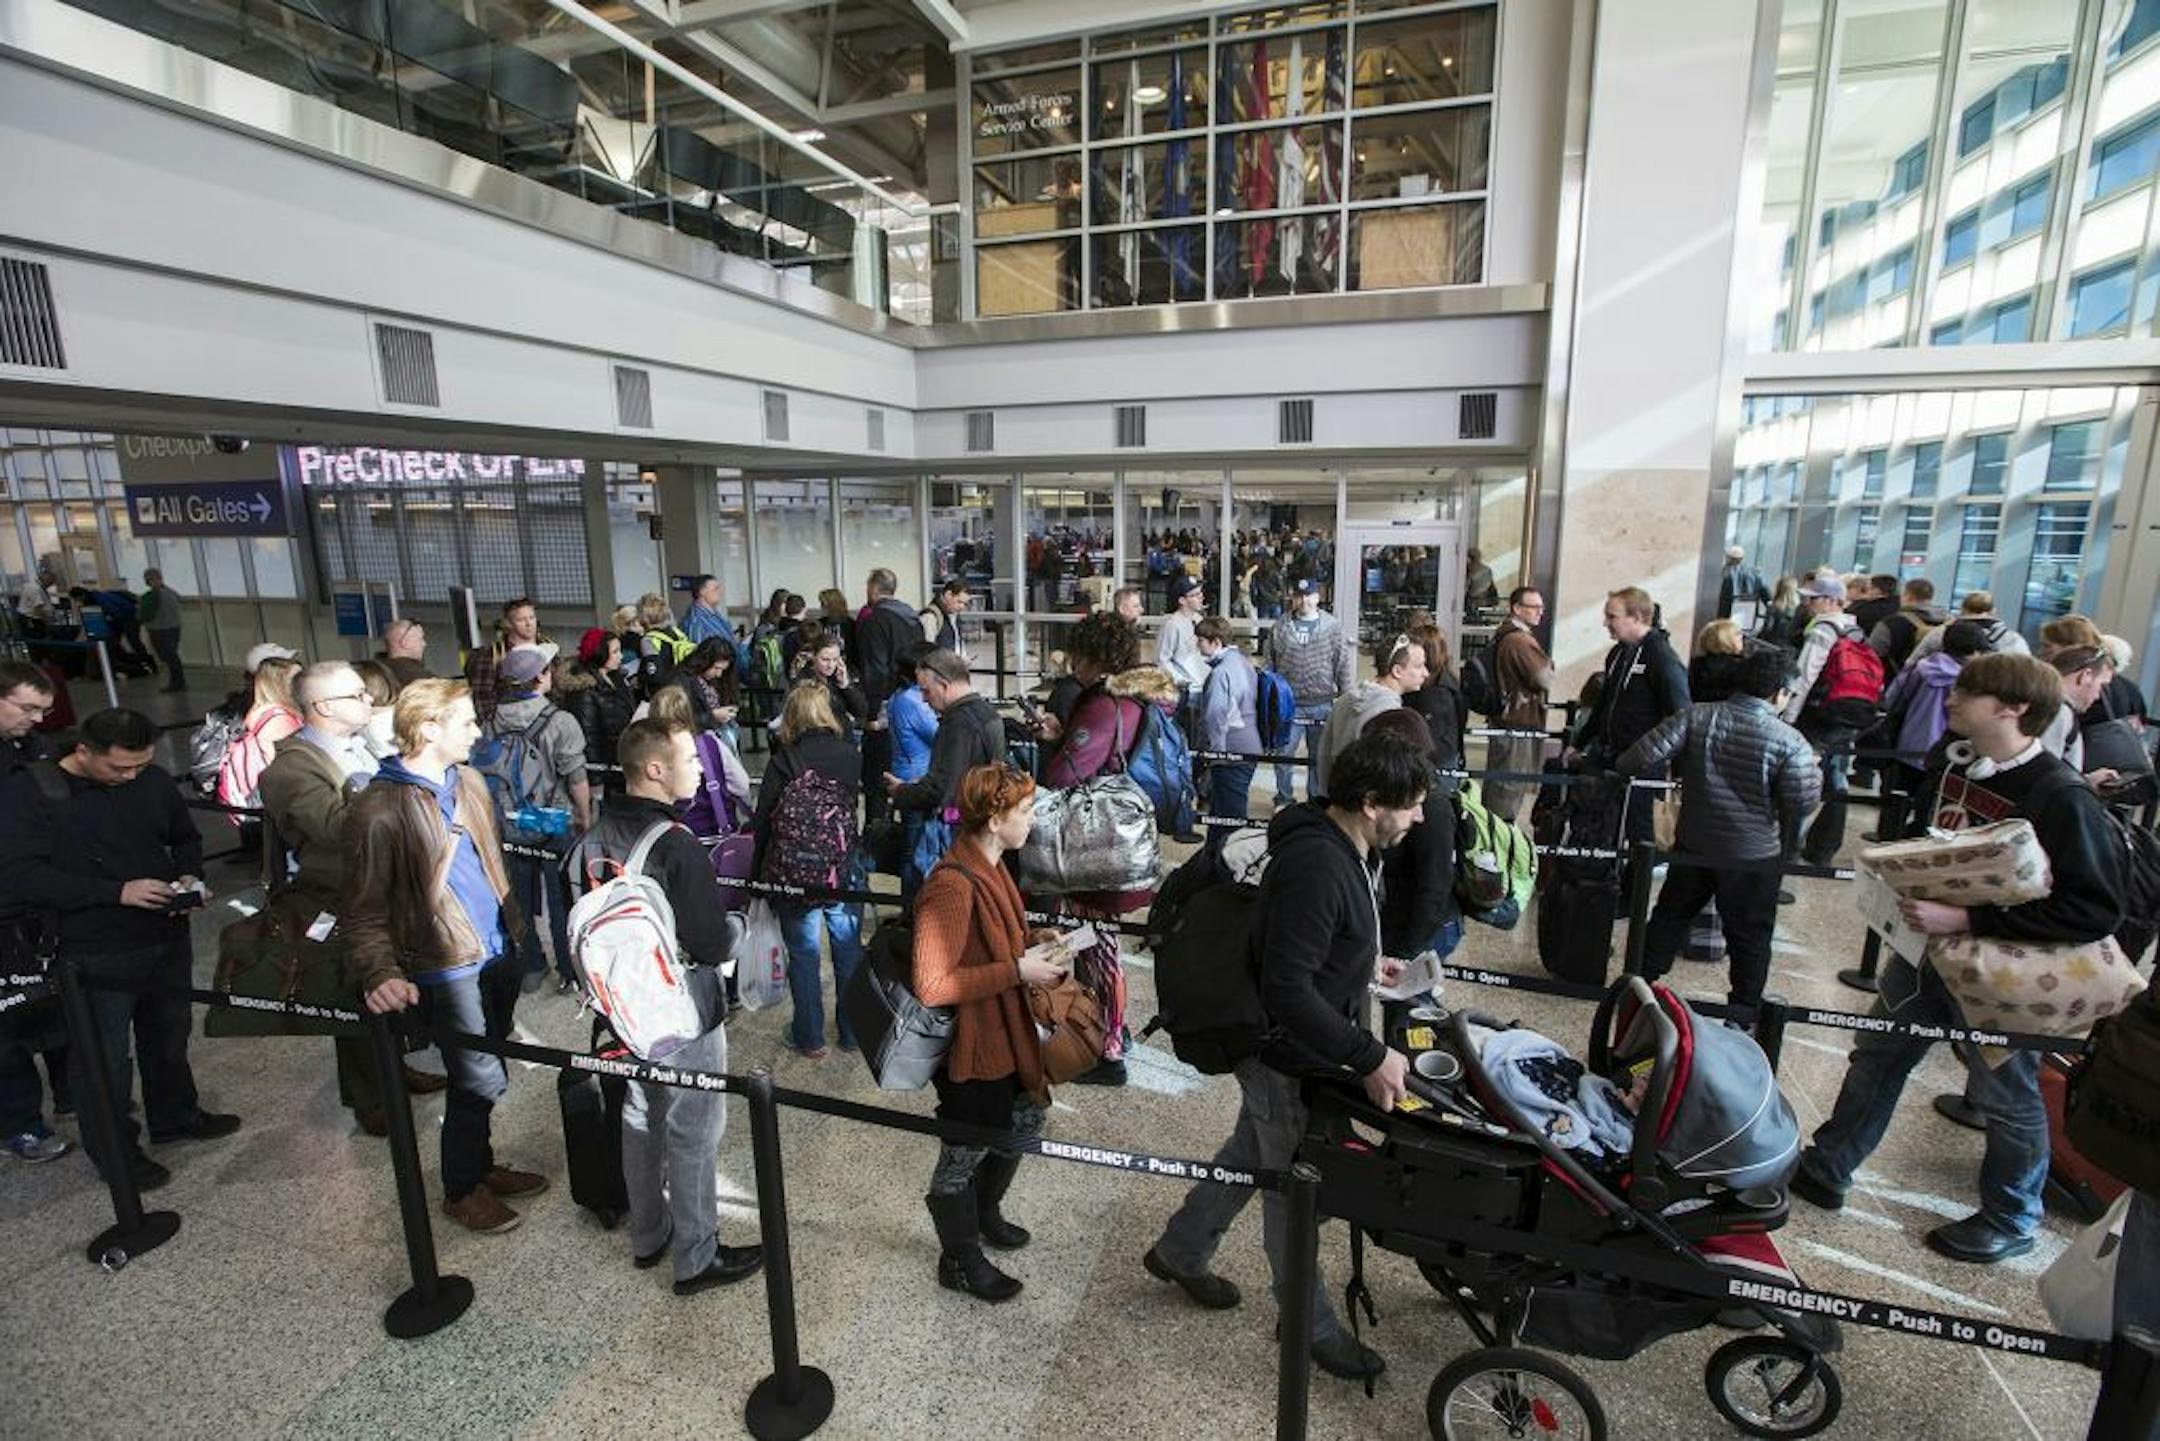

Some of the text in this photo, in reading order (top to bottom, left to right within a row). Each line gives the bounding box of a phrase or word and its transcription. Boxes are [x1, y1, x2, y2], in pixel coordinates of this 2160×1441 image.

[982, 94, 1072, 116] Armed Forces
[981, 114, 1073, 136] Service Center
[298, 446, 467, 484] PreCheck
[158, 495, 251, 524] All Gates
[1556, 846, 1579, 857] Push
[1581, 847, 1591, 857] to
[1592, 848, 1617, 858] Open
[9, 974, 43, 986] Open
[1462, 969, 1475, 981] to
[1478, 971, 1509, 986] Open
[0, 992, 26, 1012] pen
[229, 995, 286, 1012] EMERGENCY
[294, 1003, 319, 1016] Push
[320, 1007, 332, 1018] to
[333, 1008, 359, 1021] Open
[1808, 1011, 1895, 1032] EMERGENCY
[1910, 1023, 1944, 1038] Push
[1951, 1028, 1966, 1041] to
[1972, 1030, 2009, 1046] Open
[571, 1055, 640, 1077] EMERGENCY
[650, 1067, 677, 1083] Push
[681, 1072, 693, 1086] to
[697, 1073, 727, 1090] Open
[1040, 1140, 1132, 1167] EMERGENCY
[1149, 1158, 1185, 1176] Push
[1191, 1164, 1208, 1178] to
[1213, 1168, 1254, 1185] Open
[1728, 1279, 1864, 1319] EMERGENCY
[1888, 1310, 1942, 1335] Push
[1952, 1322, 1975, 1339] to
[1985, 1326, 2047, 1353] Open
